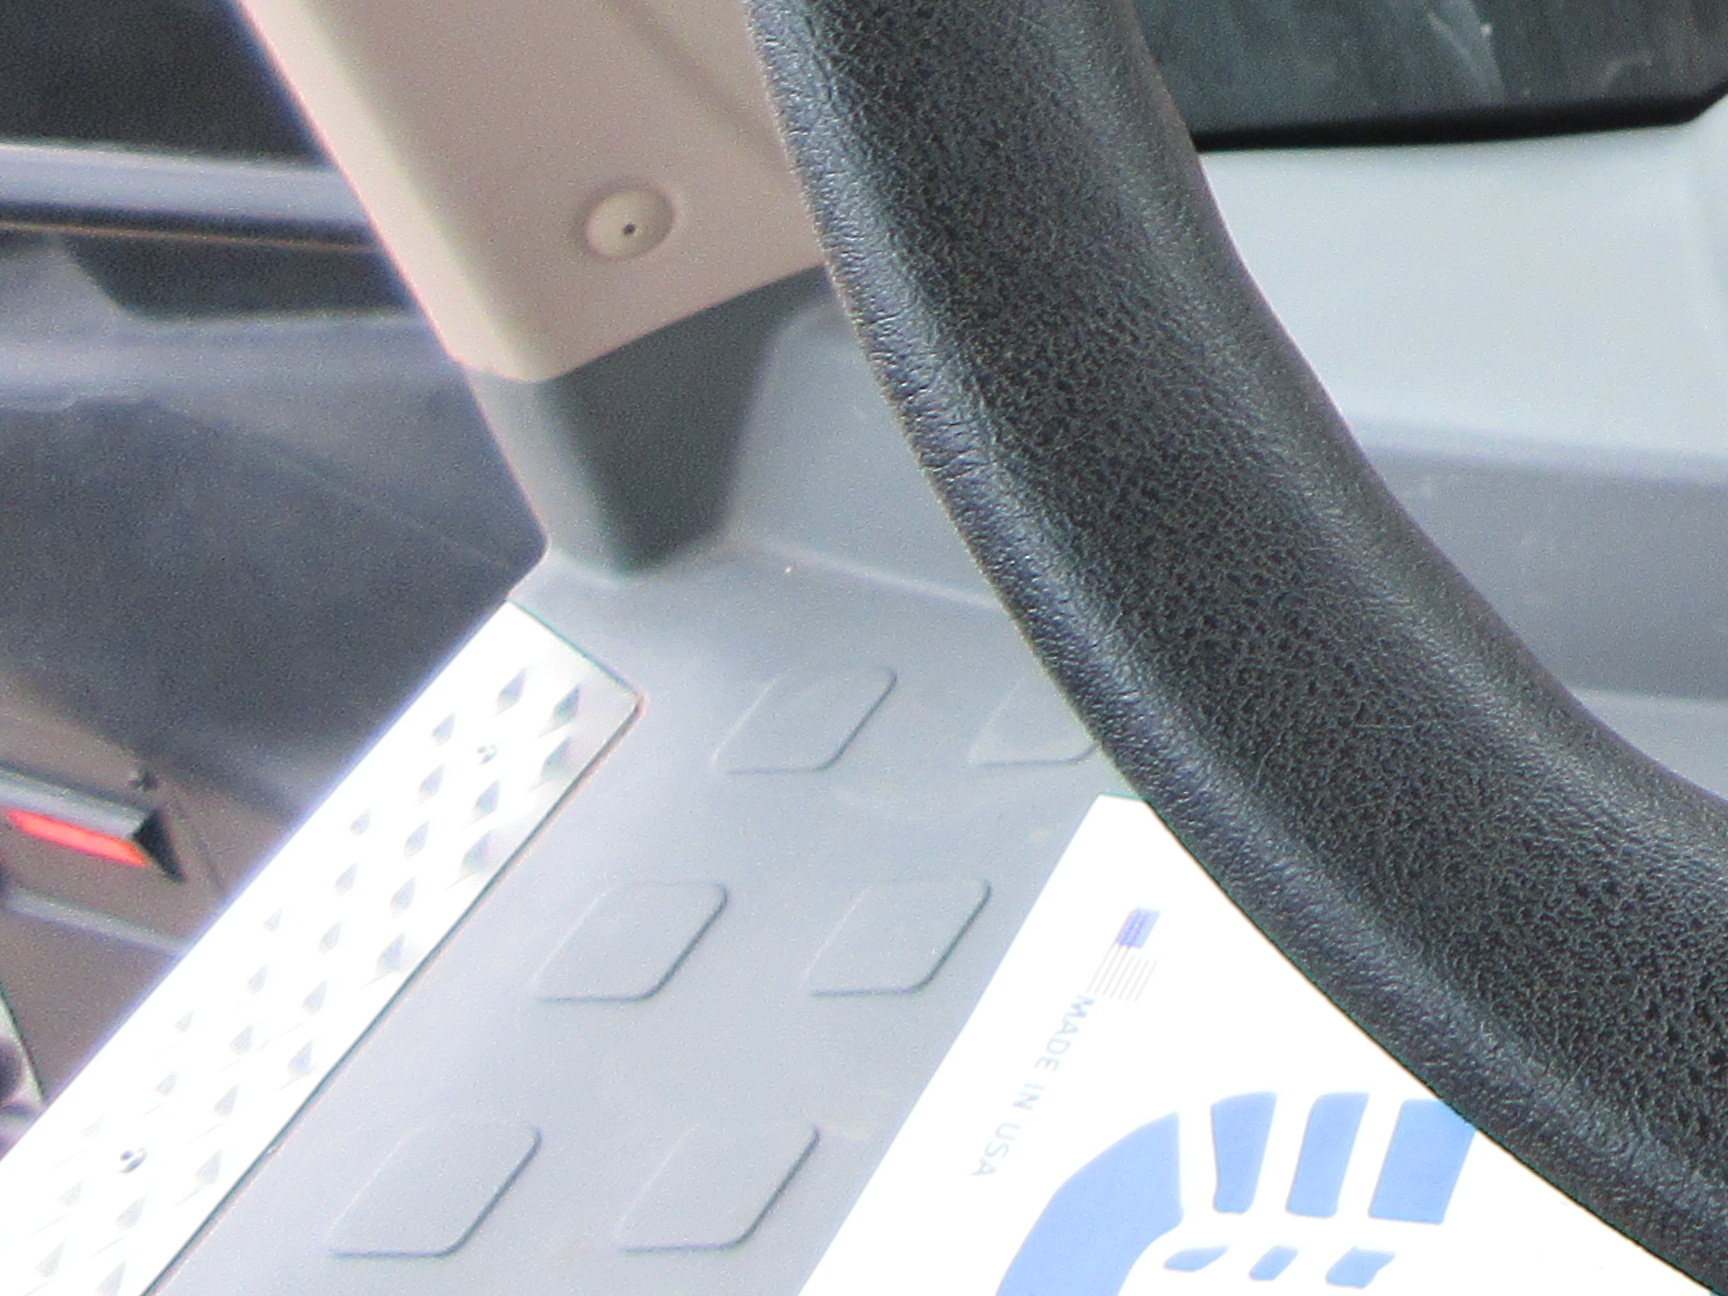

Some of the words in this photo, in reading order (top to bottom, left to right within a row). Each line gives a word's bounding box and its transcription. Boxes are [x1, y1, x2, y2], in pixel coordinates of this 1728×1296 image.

[1034, 993, 1096, 1072] MADE
[1012, 1082, 1045, 1111] IN
[970, 1121, 1022, 1177] USA
